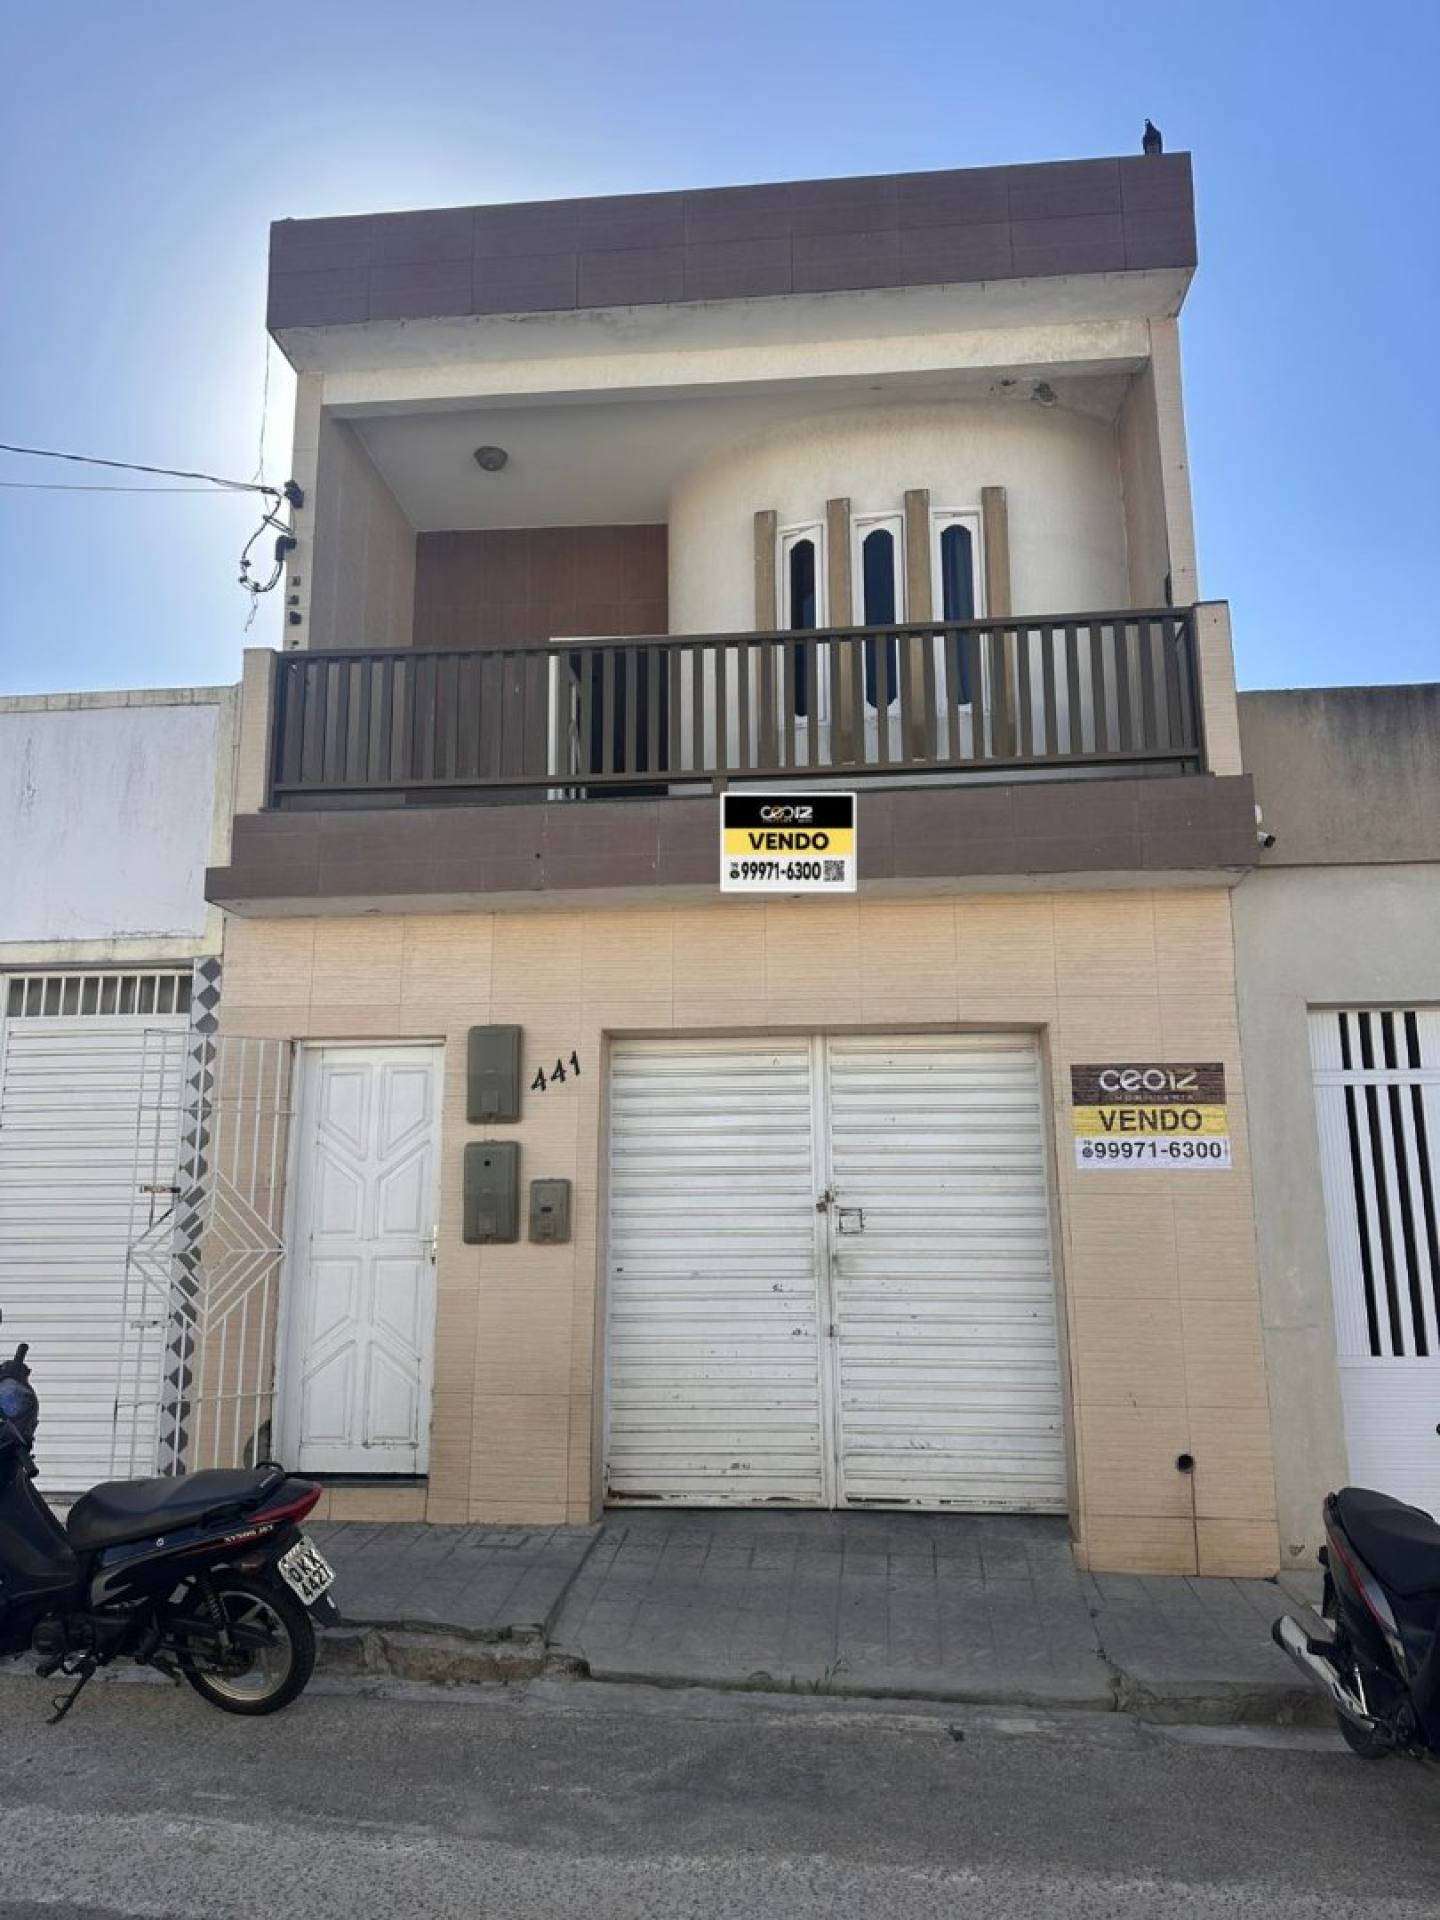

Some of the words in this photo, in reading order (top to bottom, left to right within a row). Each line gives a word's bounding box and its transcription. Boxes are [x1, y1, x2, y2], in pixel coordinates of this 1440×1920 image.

[748, 832, 830, 850] VENDO
[741, 861, 821, 880] 99971-6300
[530, 1050, 580, 1091] 441
[1098, 1109, 1202, 1131] VENDO
[1094, 1142, 1221, 1158] 99971-6300
